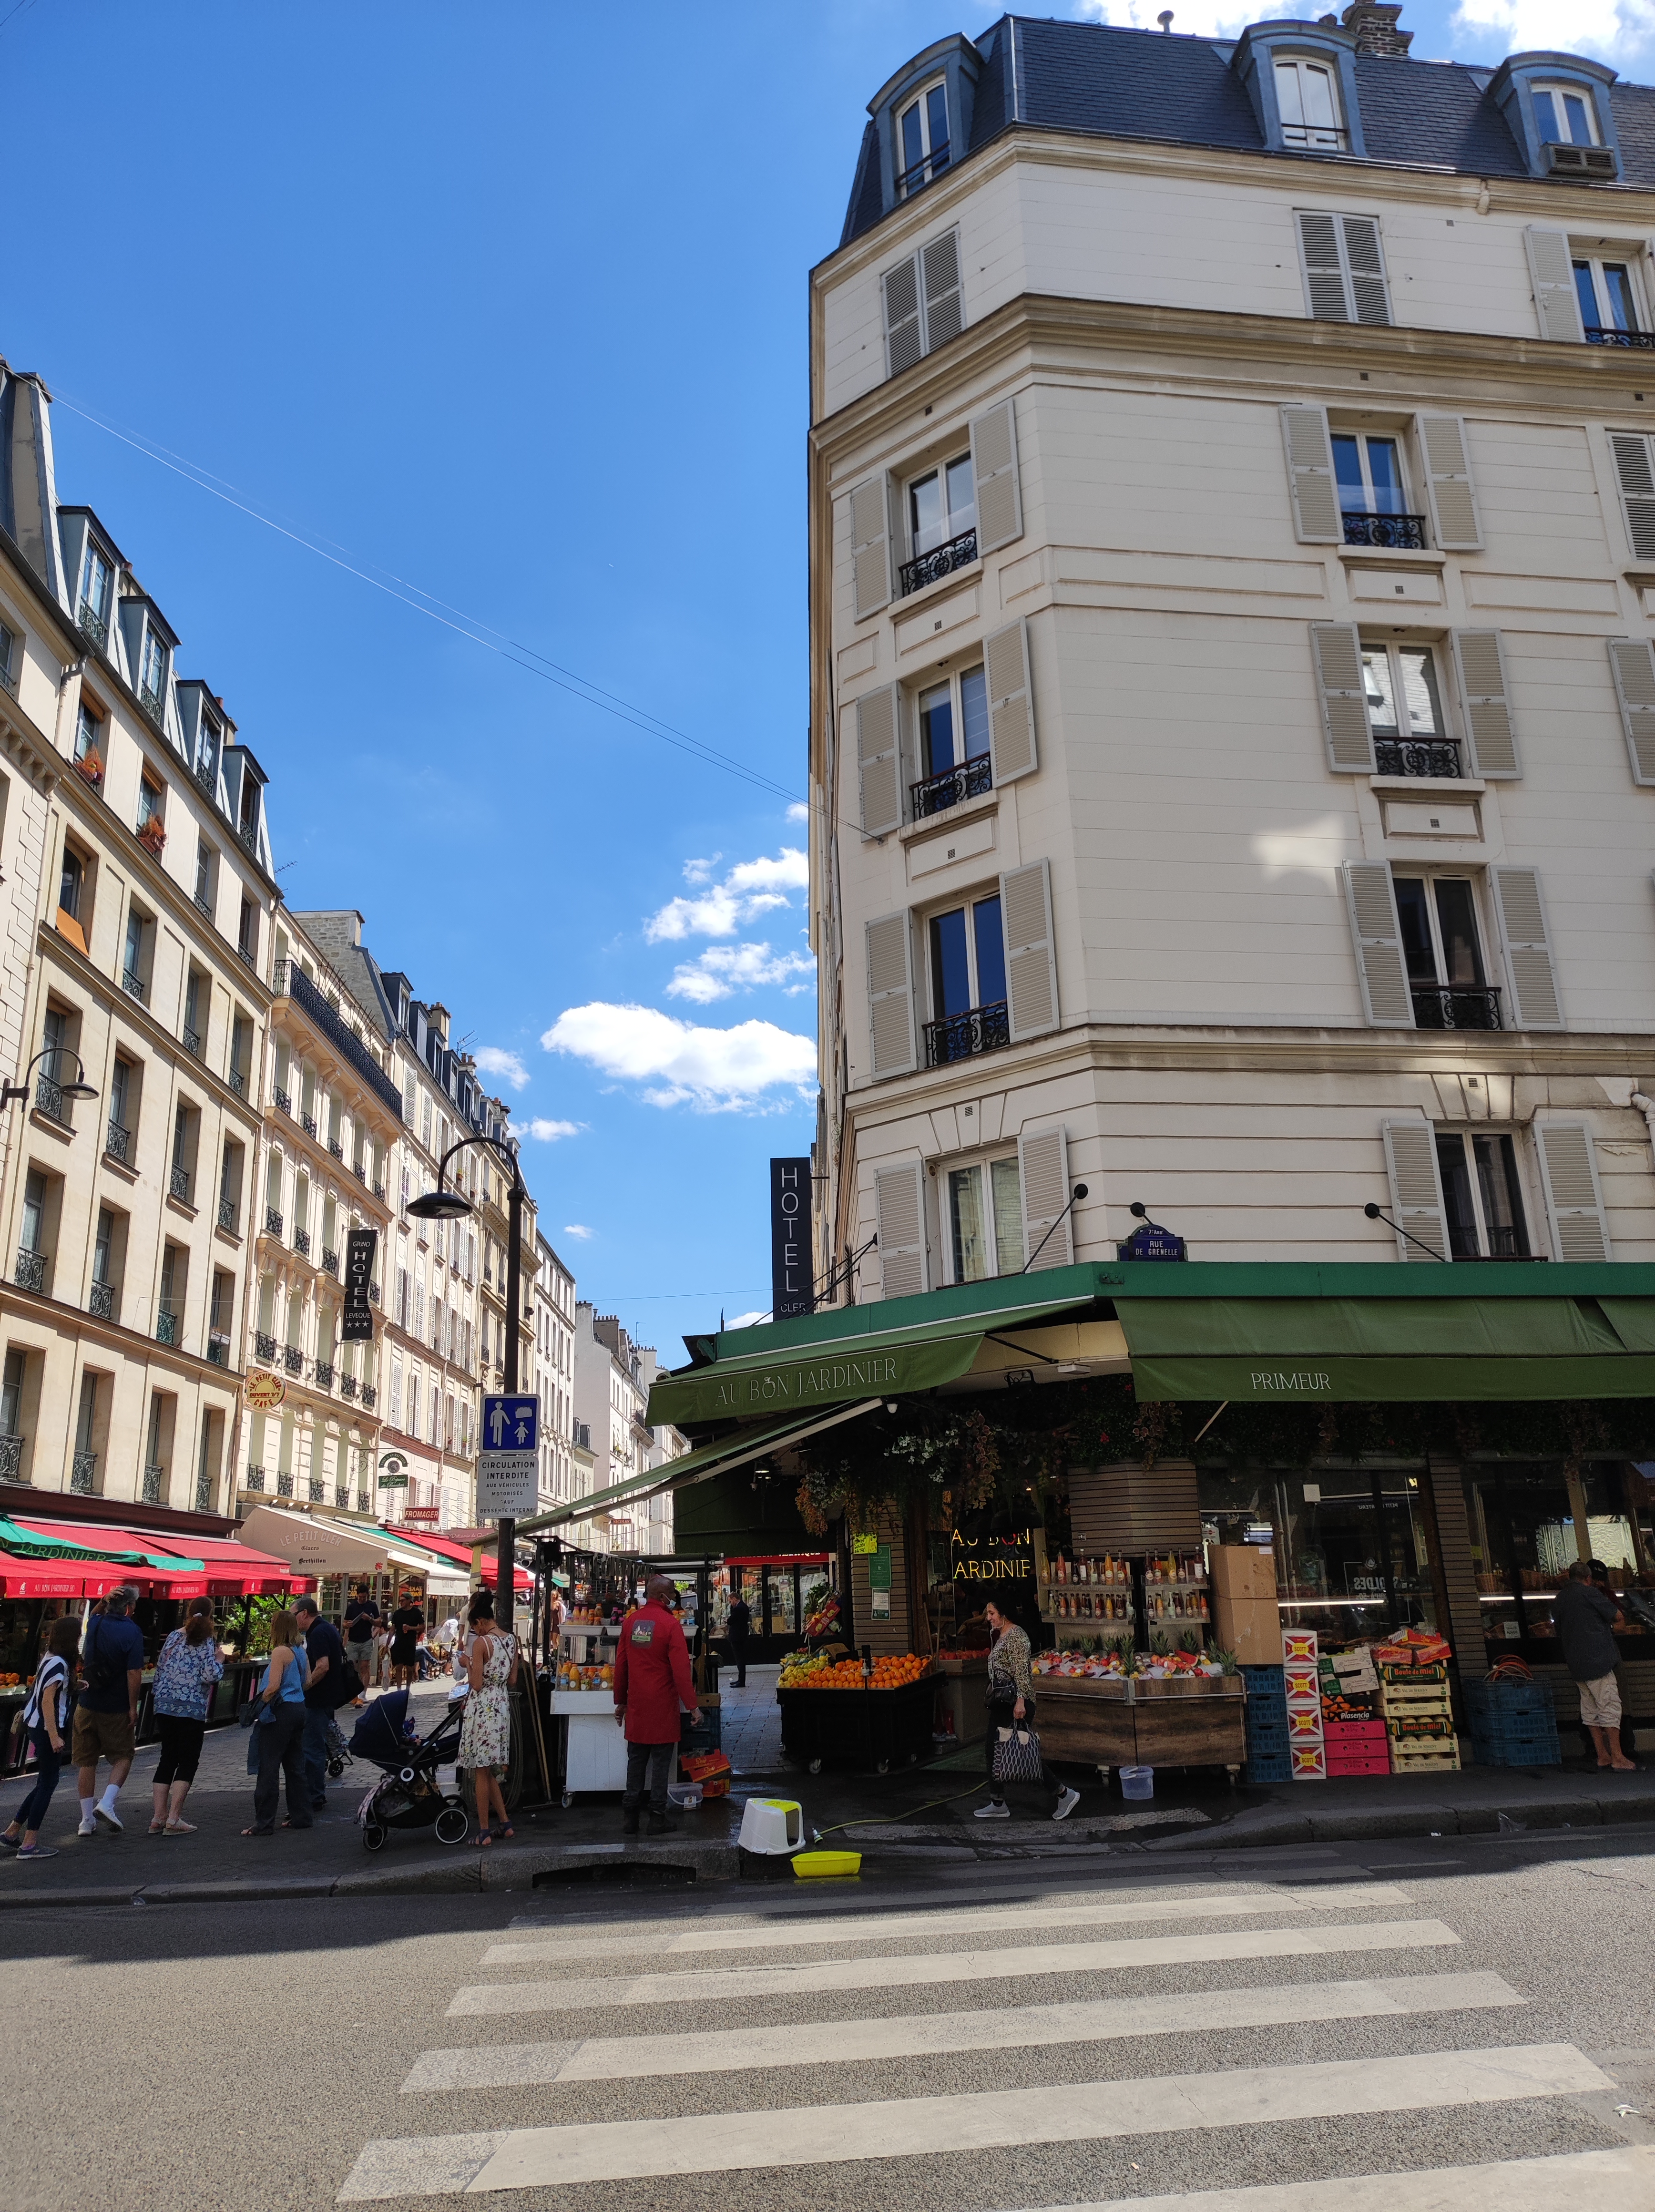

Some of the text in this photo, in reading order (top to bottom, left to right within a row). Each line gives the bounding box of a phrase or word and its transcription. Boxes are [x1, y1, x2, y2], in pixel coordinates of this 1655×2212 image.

[781, 1167, 799, 1292] HOTEL
[352, 1251, 367, 1308] HOTEL
[780, 1302, 807, 1312] CLER
[255, 1373, 271, 1382] PETIT
[271, 1376, 282, 1389] CLER
[715, 1357, 897, 1406] AU BON JARDINIER
[1250, 1373, 1332, 1390] PRIMEUR
[254, 1399, 274, 1408] CAFE
[405, 1510, 439, 1518] FROMAGER
[280, 1531, 342, 1547] LE PETIT CLER
[41, 1584, 50, 1592] BON
[51, 1584, 69, 1593] JARDINIER
[1340, 1711, 1369, 1719] Plasencia
